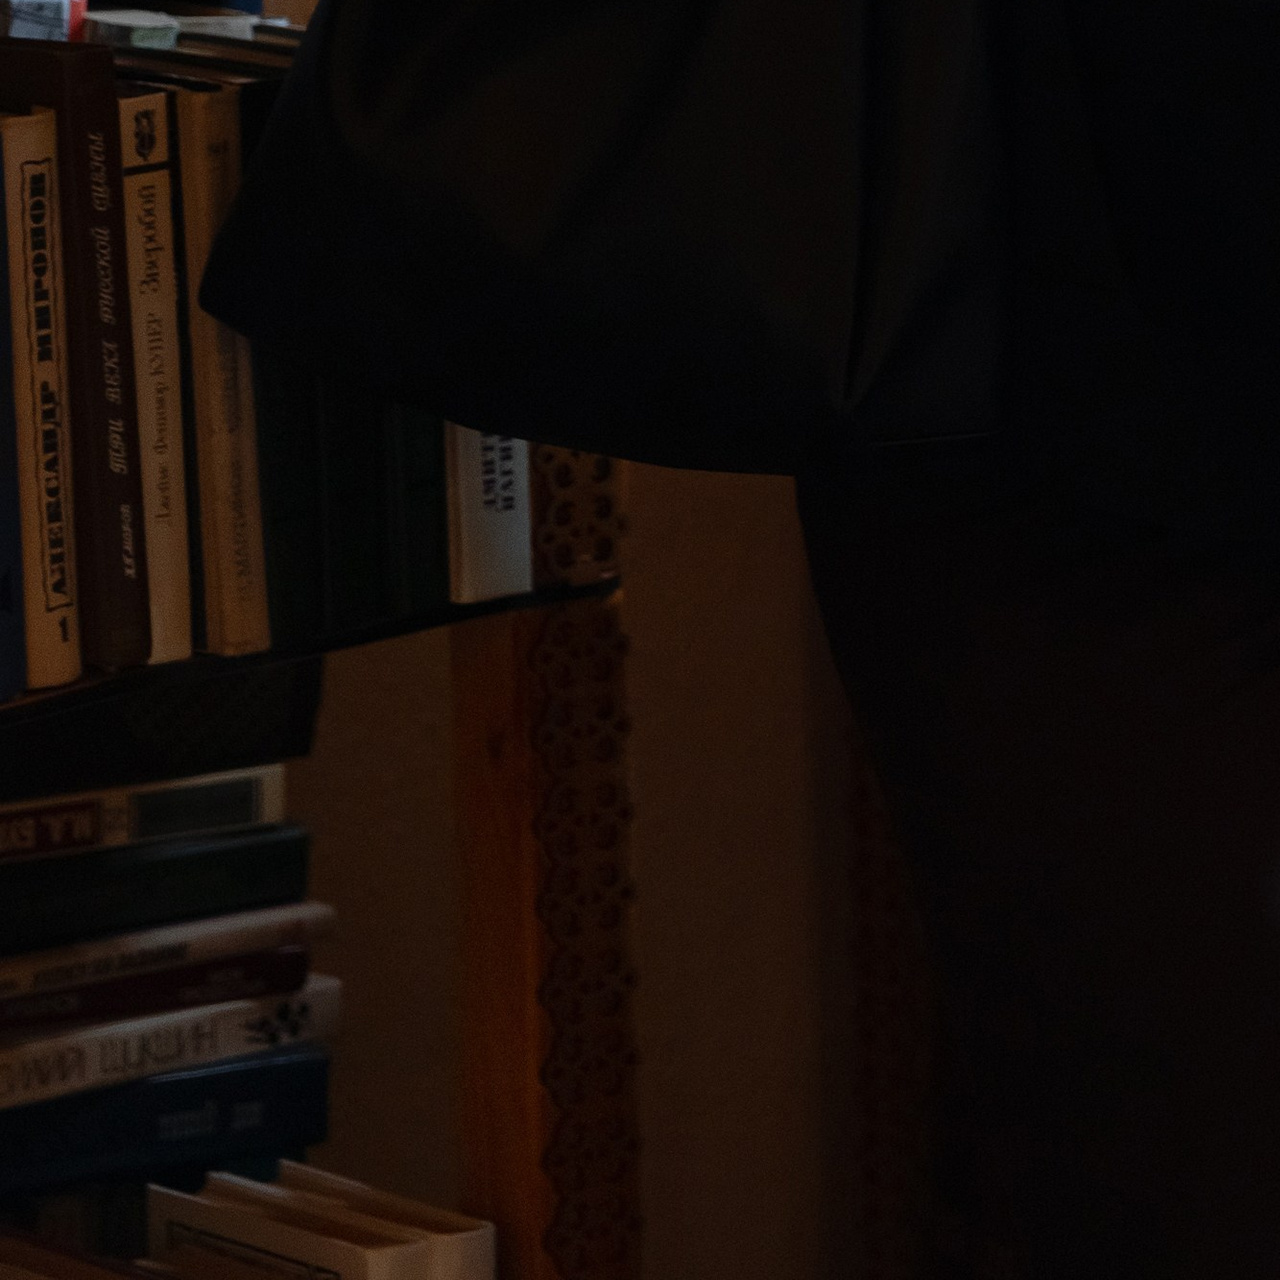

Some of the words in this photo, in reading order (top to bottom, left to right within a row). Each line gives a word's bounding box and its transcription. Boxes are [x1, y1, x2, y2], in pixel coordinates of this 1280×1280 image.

[87, 130, 113, 212] СЦЕНЫ
[28, 172, 54, 363] МИРОНОВ
[91, 226, 117, 325] РУССКОЙ
[135, 184, 163, 296] Зверобой
[100, 341, 123, 405] ВЕКА
[147, 311, 168, 376] КУПЕР
[40, 380, 67, 597] АЛЕКСАНДР
[106, 419, 129, 474] ТРИ
